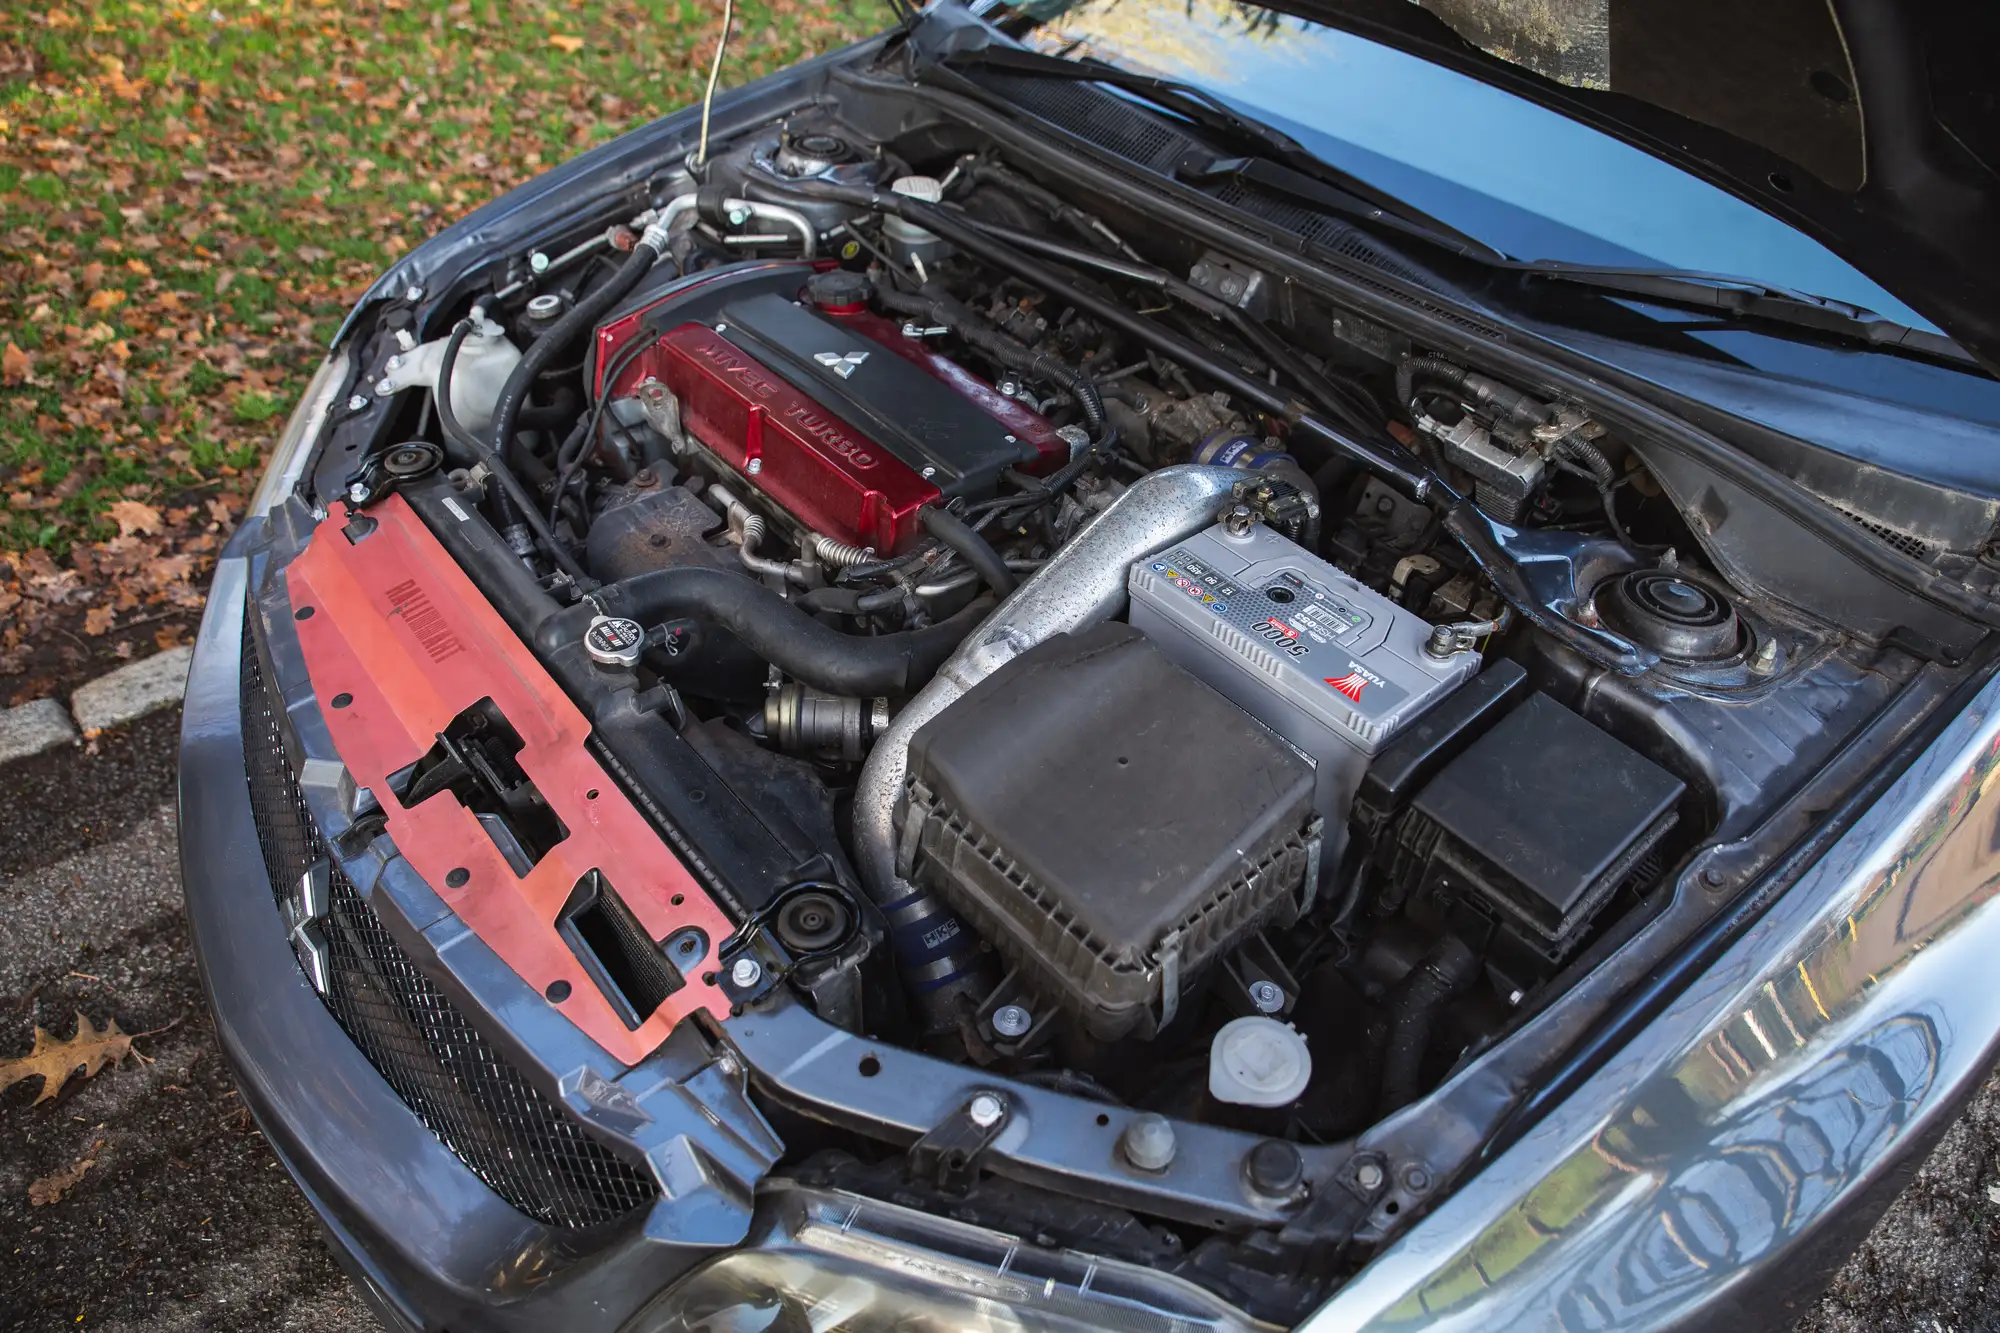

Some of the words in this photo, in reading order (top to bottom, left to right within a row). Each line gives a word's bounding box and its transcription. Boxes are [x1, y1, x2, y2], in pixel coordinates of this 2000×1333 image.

[695, 343, 780, 399] MIVEC
[784, 401, 879, 470] TURBO
[1187, 564, 1203, 576] 450
[1205, 576, 1218, 586] 50
[1222, 587, 1233, 595] 12
[385, 578, 467, 664] RALLIART
[619, 624, 638, 640] CAUTION
[1294, 612, 1336, 640] HSB053
[1250, 621, 1310, 657] 5000
[1348, 660, 1386, 688] YUASA
[921, 917, 960, 949] HKS
